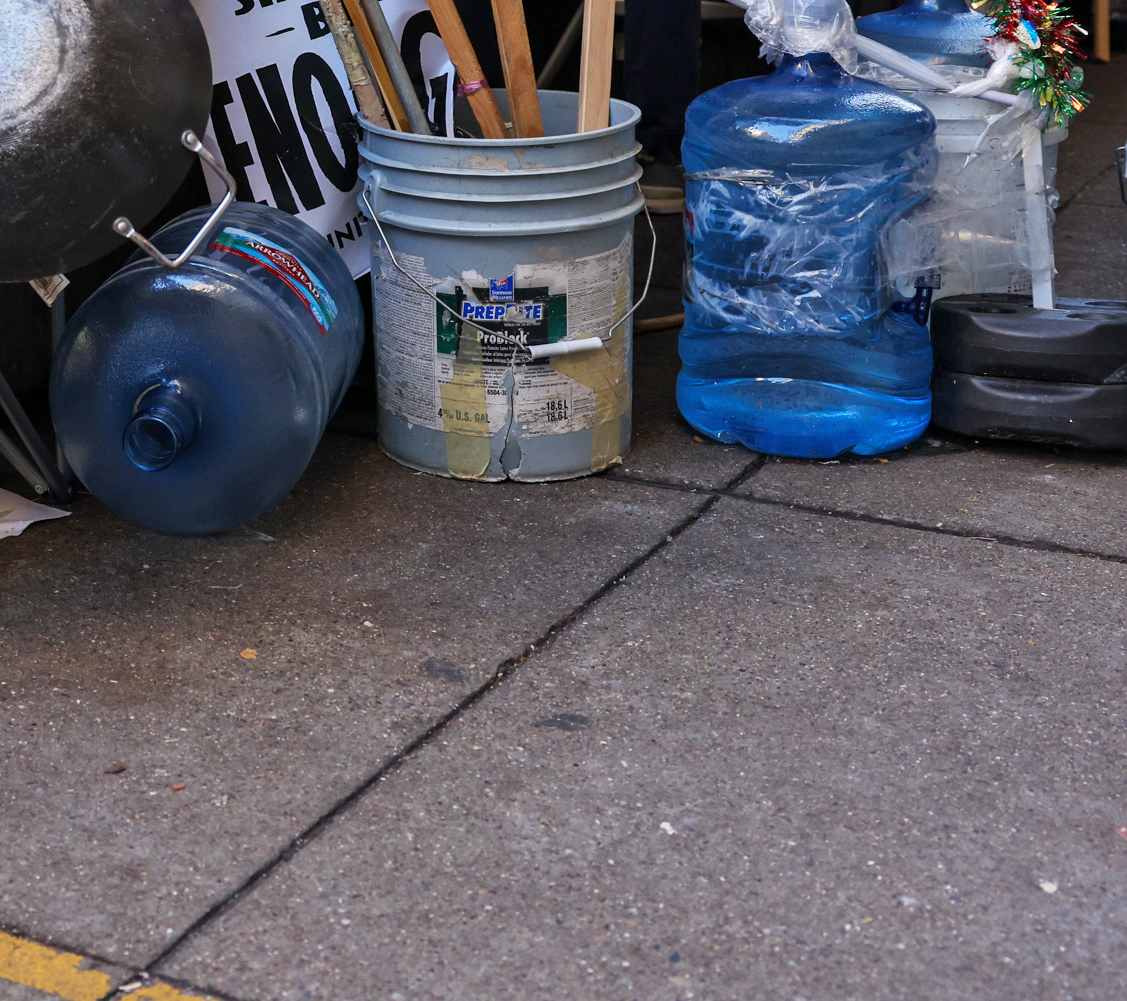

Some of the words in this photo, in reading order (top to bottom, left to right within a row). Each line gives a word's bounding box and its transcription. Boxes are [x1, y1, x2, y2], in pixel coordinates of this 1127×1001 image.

[245, 240, 321, 299] ARROWHEAD
[455, 409, 472, 423] U.S.
[474, 412, 491, 424] GAL
